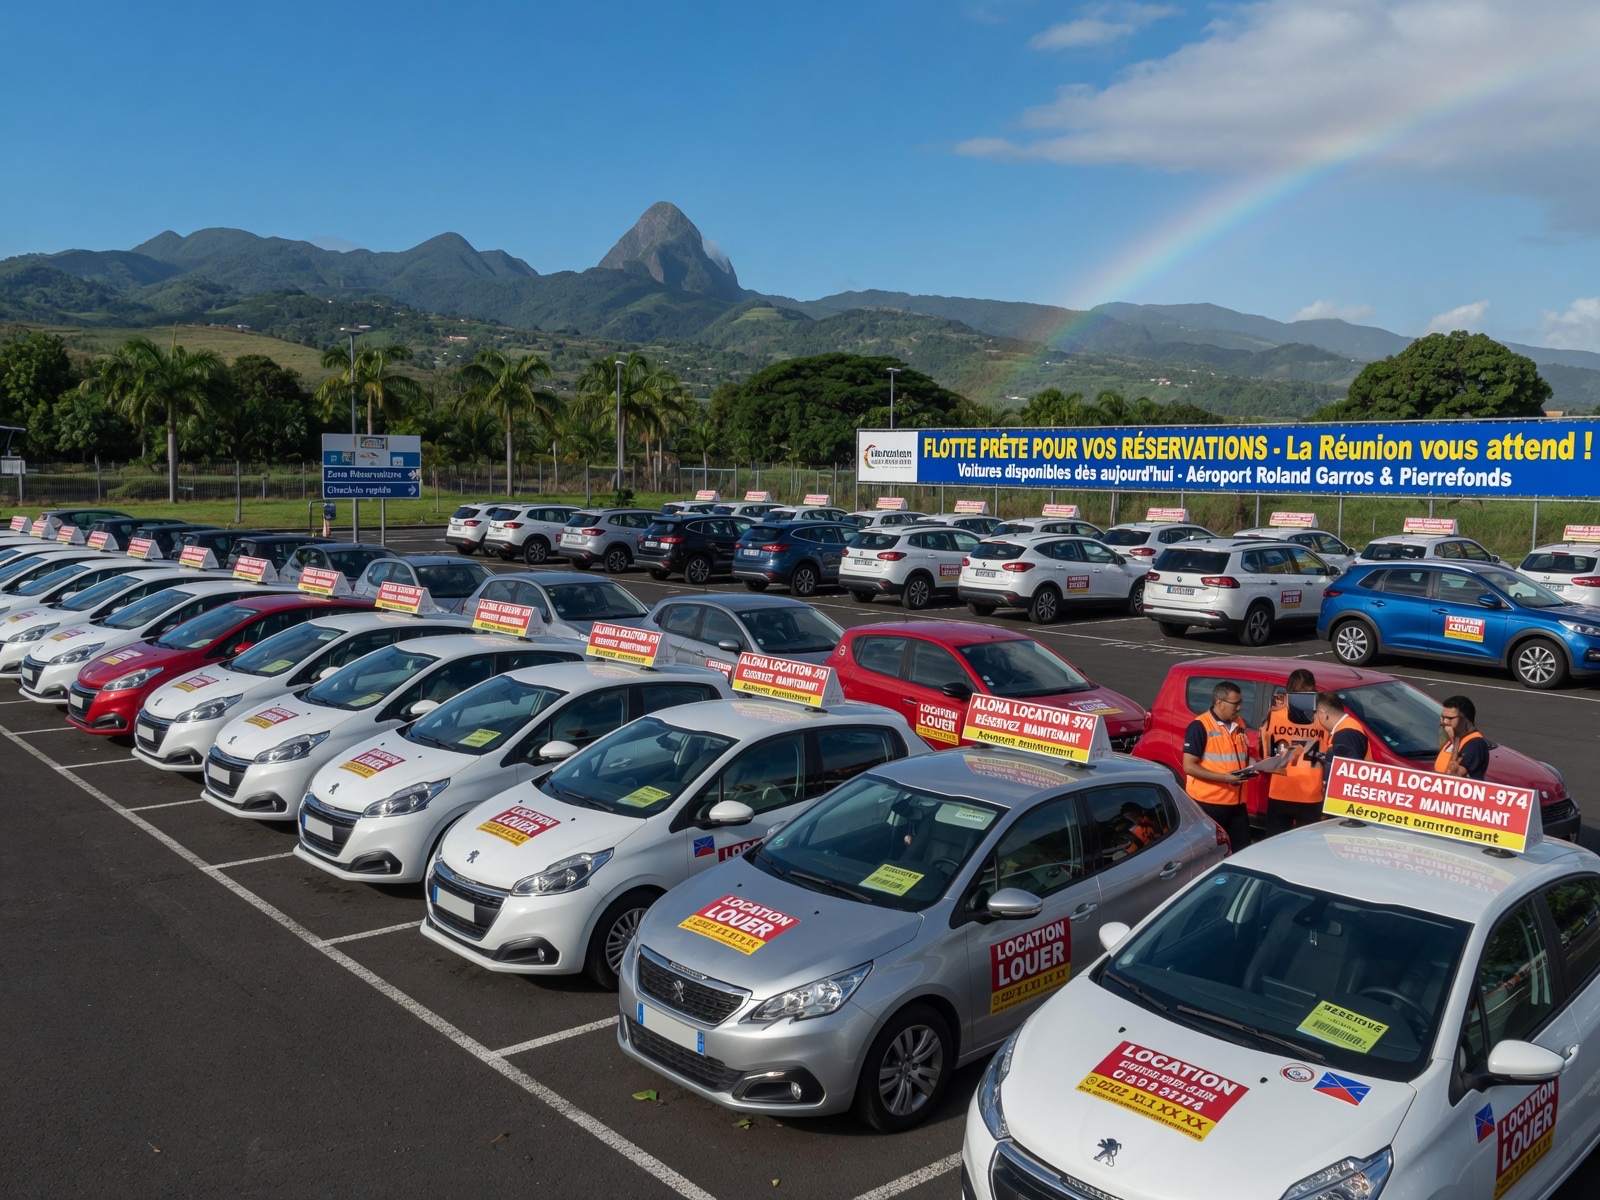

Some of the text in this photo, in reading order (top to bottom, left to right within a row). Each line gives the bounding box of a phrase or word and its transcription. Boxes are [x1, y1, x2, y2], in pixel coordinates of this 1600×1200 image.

[923, 437, 976, 459] FLOTTE
[980, 433, 1030, 459] PRÊTE
[1032, 437, 1078, 460] POUR
[1082, 437, 1117, 460] VOS
[1122, 431, 1268, 460] RÉSERVATIONS
[1286, 435, 1312, 460] La
[1319, 433, 1412, 460] Réunion
[1420, 439, 1478, 460] vous
[1486, 431, 1576, 460] attend
[1584, 431, 1593, 460] !
[957, 463, 1002, 479] Voitures
[1005, 463, 1072, 483] disponibles
[1074, 464, 1097, 481] dès
[1100, 465, 1174, 485] aujourd'hui
[1186, 465, 1252, 486] Aéroport
[1256, 466, 1311, 484] Roland
[1315, 467, 1374, 486] Garros
[1380, 467, 1393, 485] &
[1400, 467, 1512, 487] Pierrefonds
[972, 697, 1011, 715] ALOHA
[1012, 705, 1070, 726] LOCATION
[1335, 762, 1529, 810] ALOHA LOCATION -974
[1342, 782, 1511, 827] RÉSERVEZ MAINTENANT
[704, 905, 775, 938] LOUER
[721, 896, 794, 927] LOCATION
[997, 920, 1066, 961] LOCATION
[998, 940, 1065, 987] LOUER
[1121, 1045, 1239, 1096] LOCATION
[1502, 1080, 1555, 1140] LOCATION
[1501, 1102, 1554, 1171] LOUER
